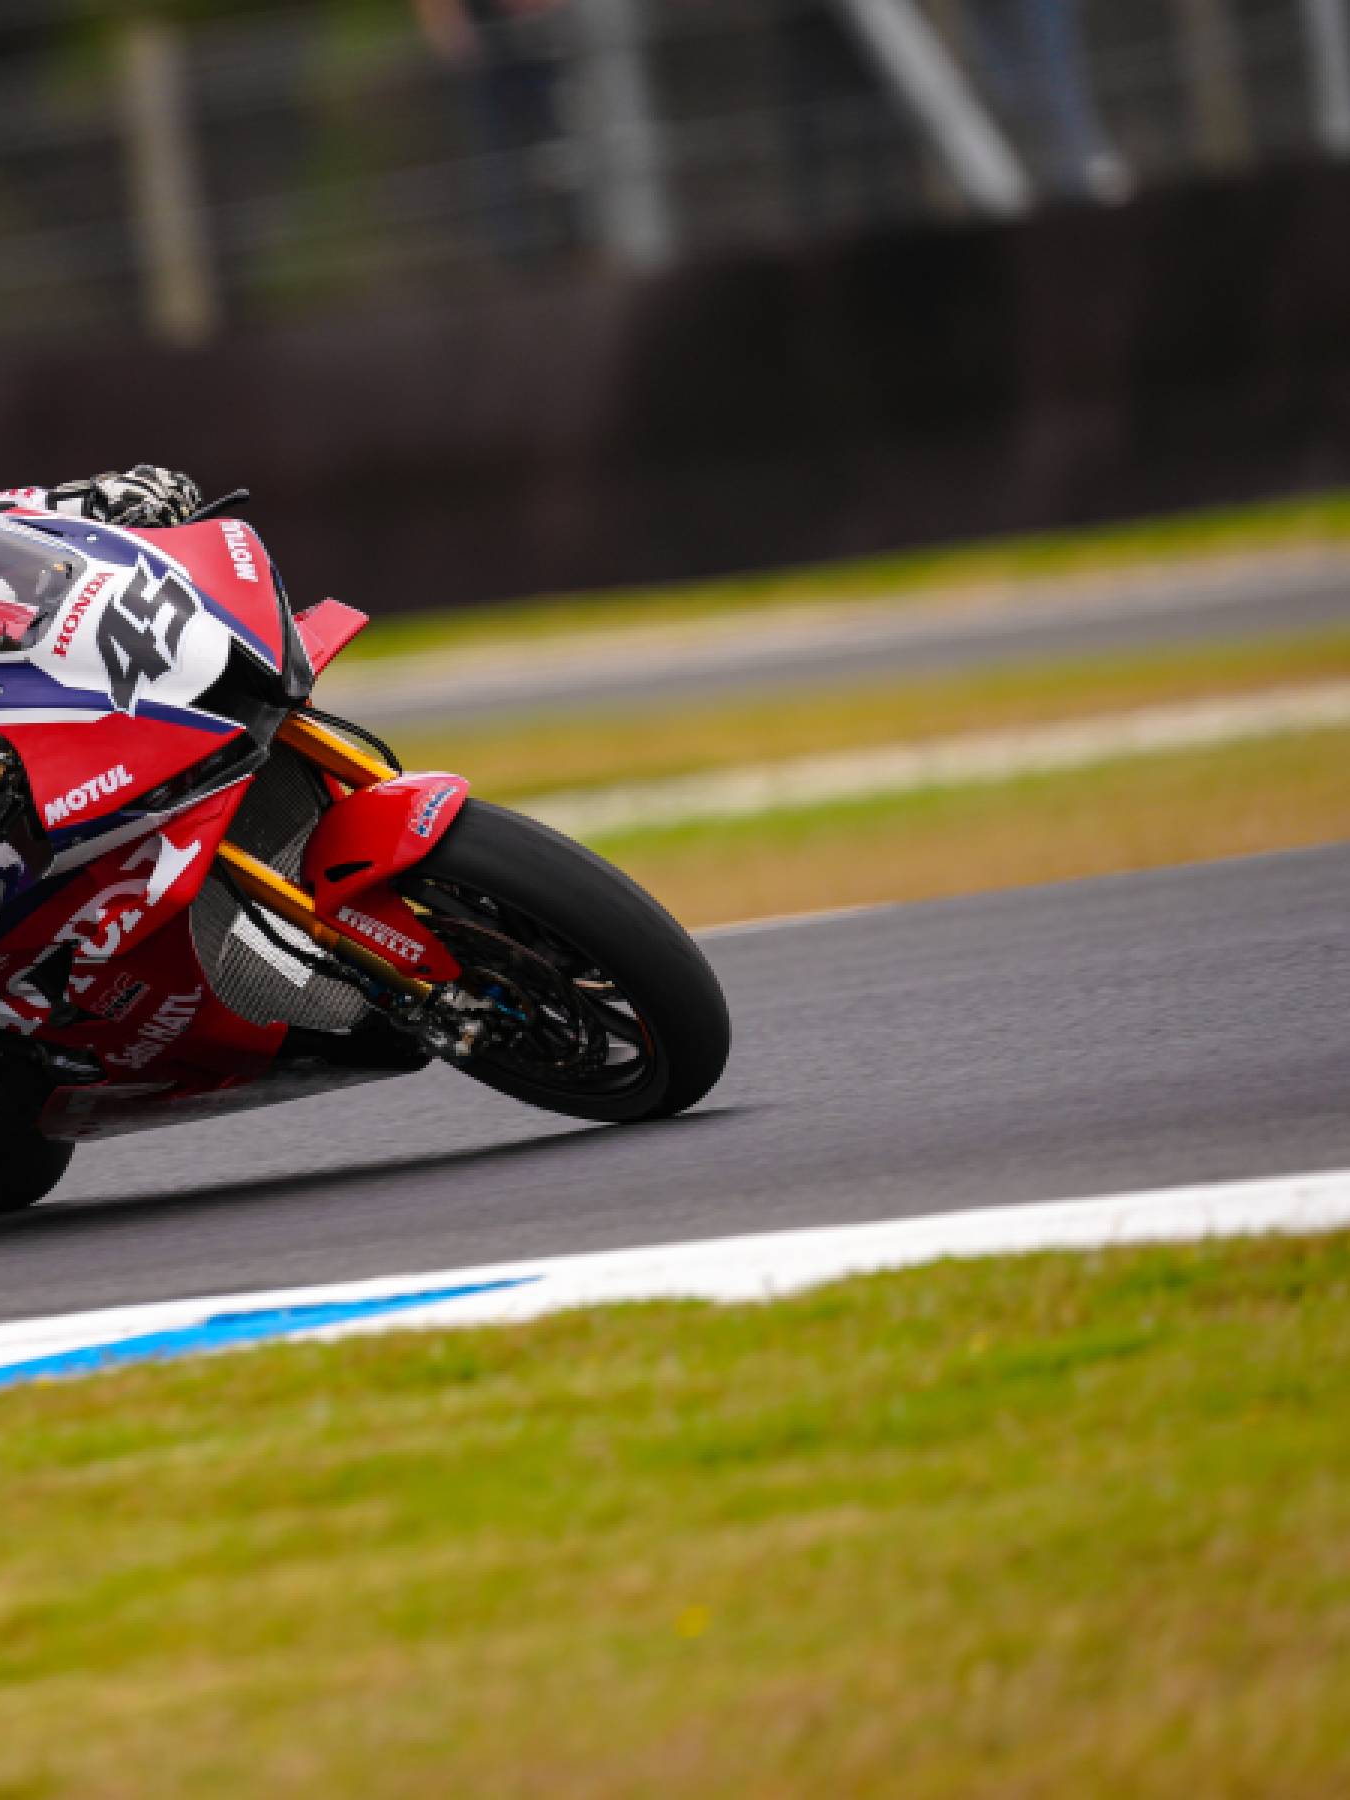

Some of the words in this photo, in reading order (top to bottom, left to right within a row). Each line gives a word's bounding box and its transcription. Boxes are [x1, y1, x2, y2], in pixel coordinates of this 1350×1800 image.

[220, 521, 258, 582] MOTUL
[52, 572, 115, 658] HONDA
[97, 555, 203, 715] 45
[45, 764, 134, 826] MOTUL
[336, 905, 426, 963] PIRELLI
